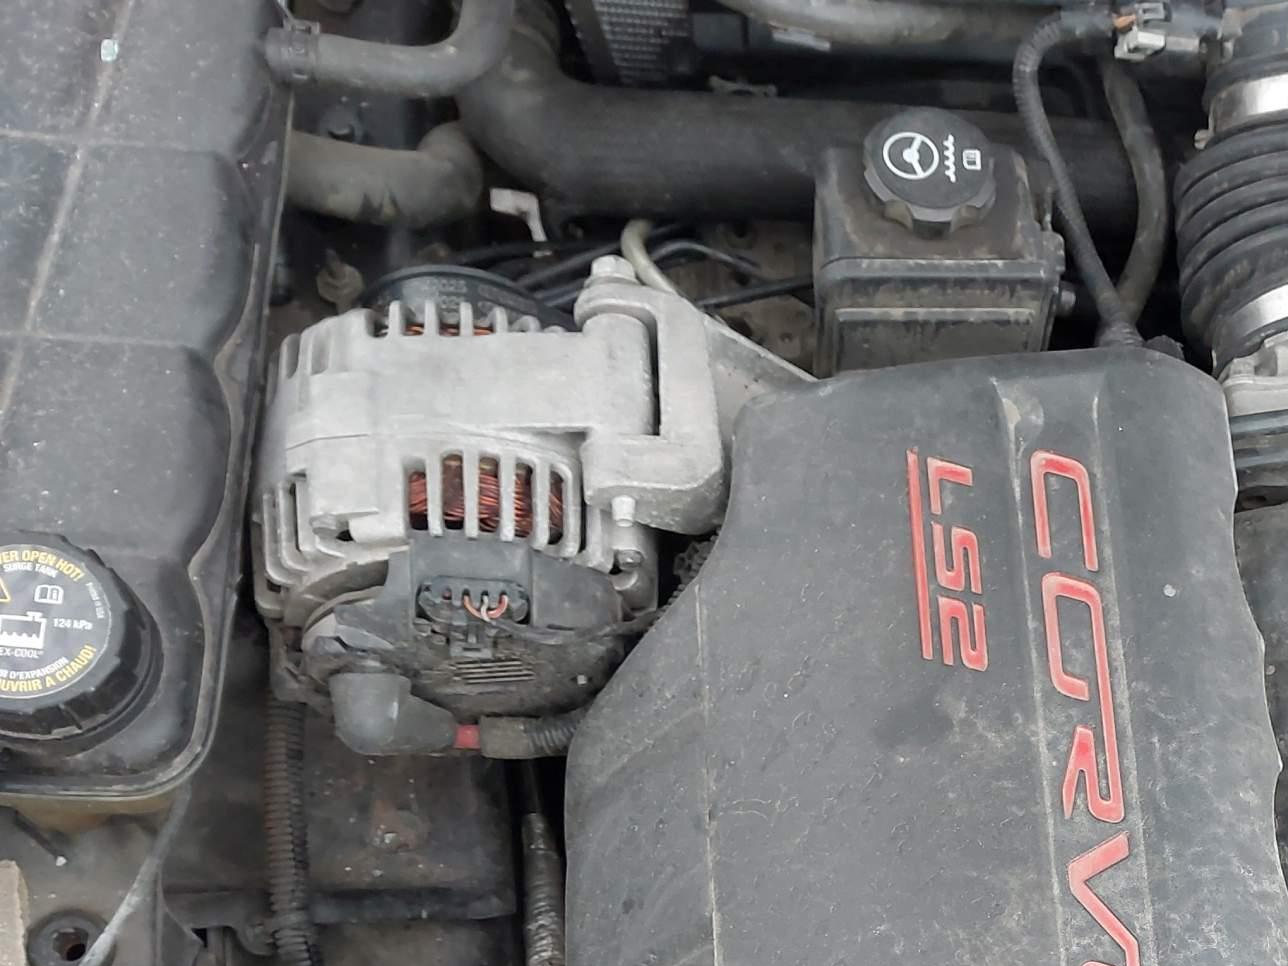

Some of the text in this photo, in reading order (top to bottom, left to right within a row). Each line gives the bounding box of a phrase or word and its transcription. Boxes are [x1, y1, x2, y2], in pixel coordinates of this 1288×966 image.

[0, 550, 19, 564] ER
[21, 550, 57, 567] OPEN
[926, 455, 989, 672] LS2
[53, 618, 71, 628] 124
[0, 678, 42, 692] UVRIR
